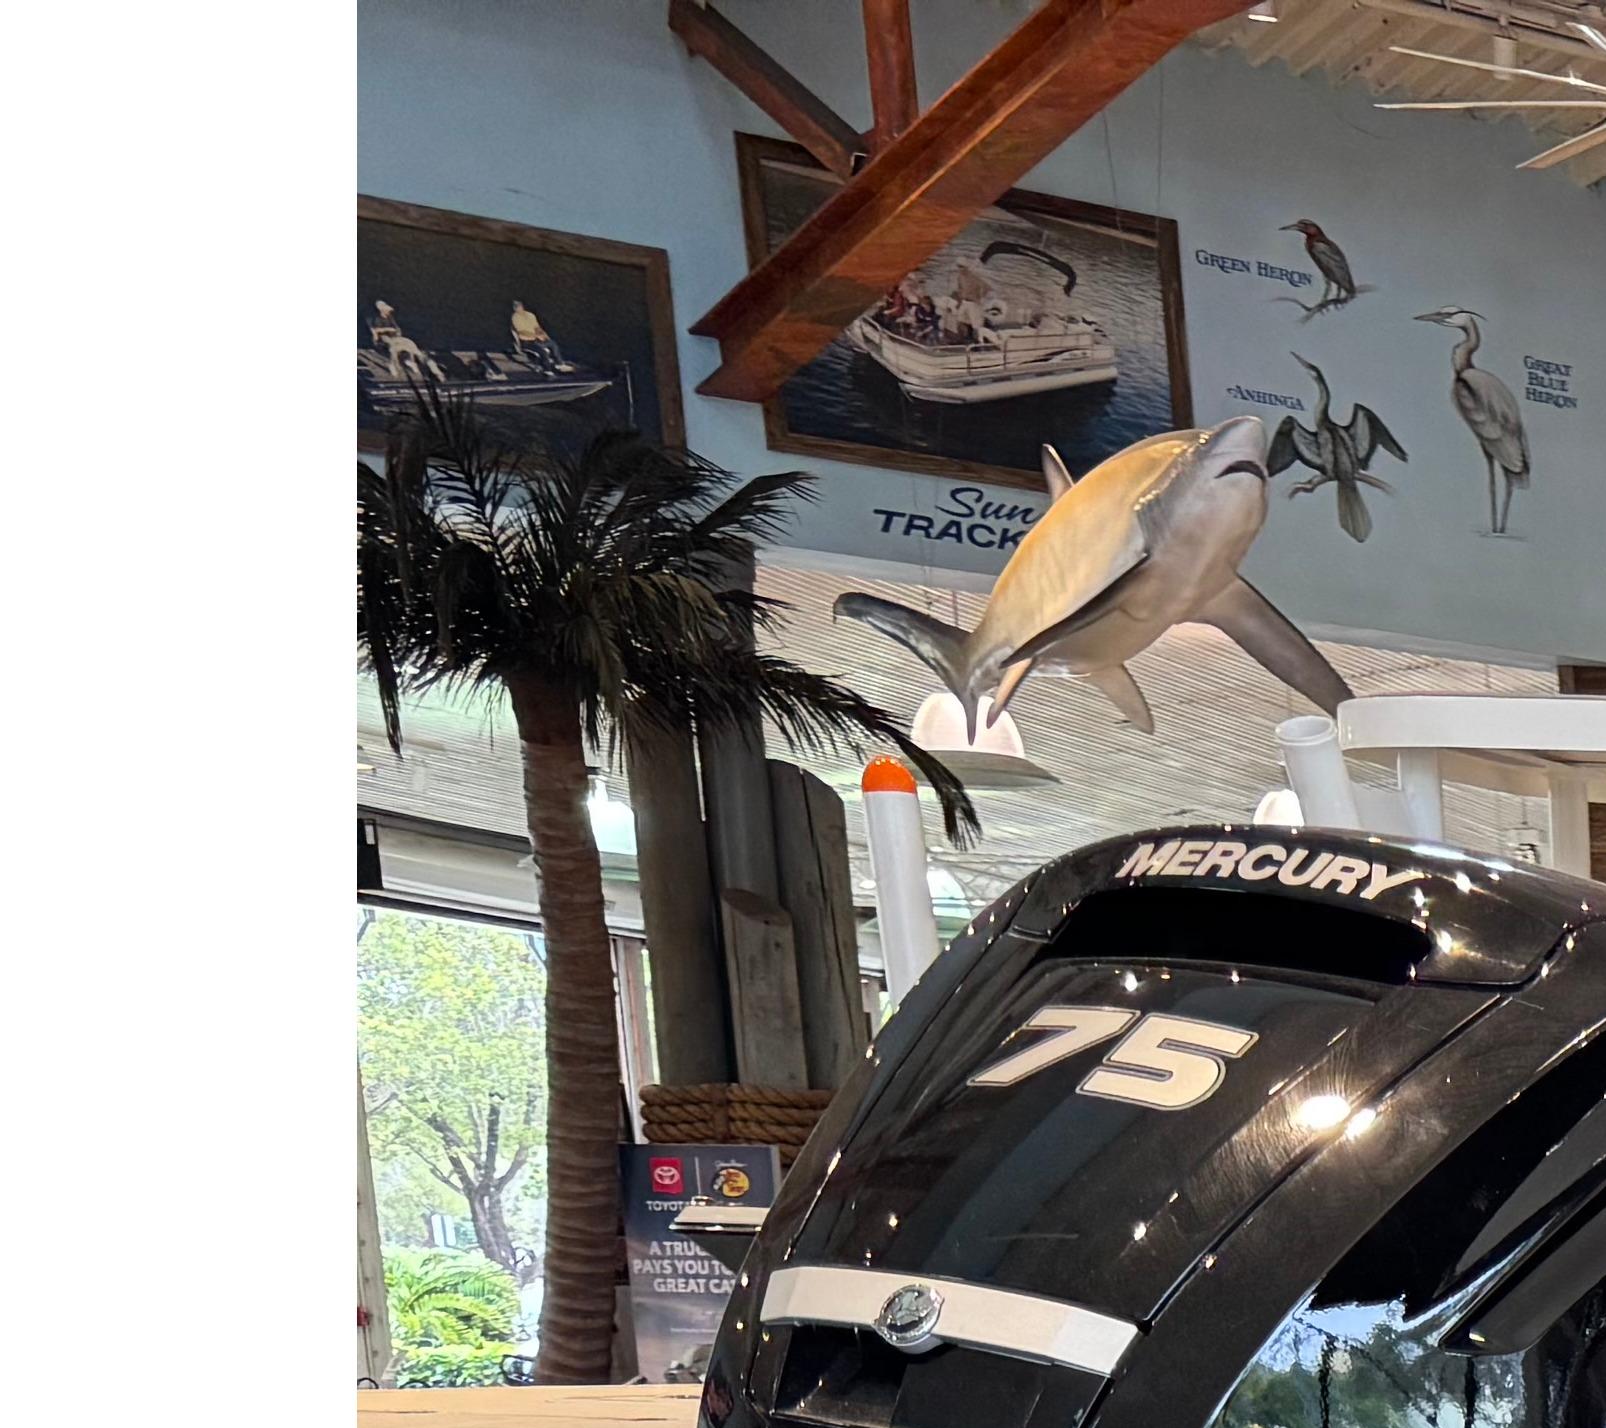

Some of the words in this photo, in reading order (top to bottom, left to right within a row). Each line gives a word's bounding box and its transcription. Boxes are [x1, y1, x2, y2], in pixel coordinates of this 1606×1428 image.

[1522, 354, 1574, 379] GREAT
[1527, 371, 1569, 392] BLUE
[1226, 384, 1306, 413] ANHINGA
[934, 486, 1037, 525] Sun
[1114, 839, 1426, 901] MERCURY
[966, 1004, 1260, 1112] 75
[645, 1200, 690, 1212] TOYOT
[650, 1241, 662, 1256] A
[632, 1259, 673, 1275] PAYS
[674, 1259, 708, 1275] YOU
[653, 1278, 701, 1294] GREAT
